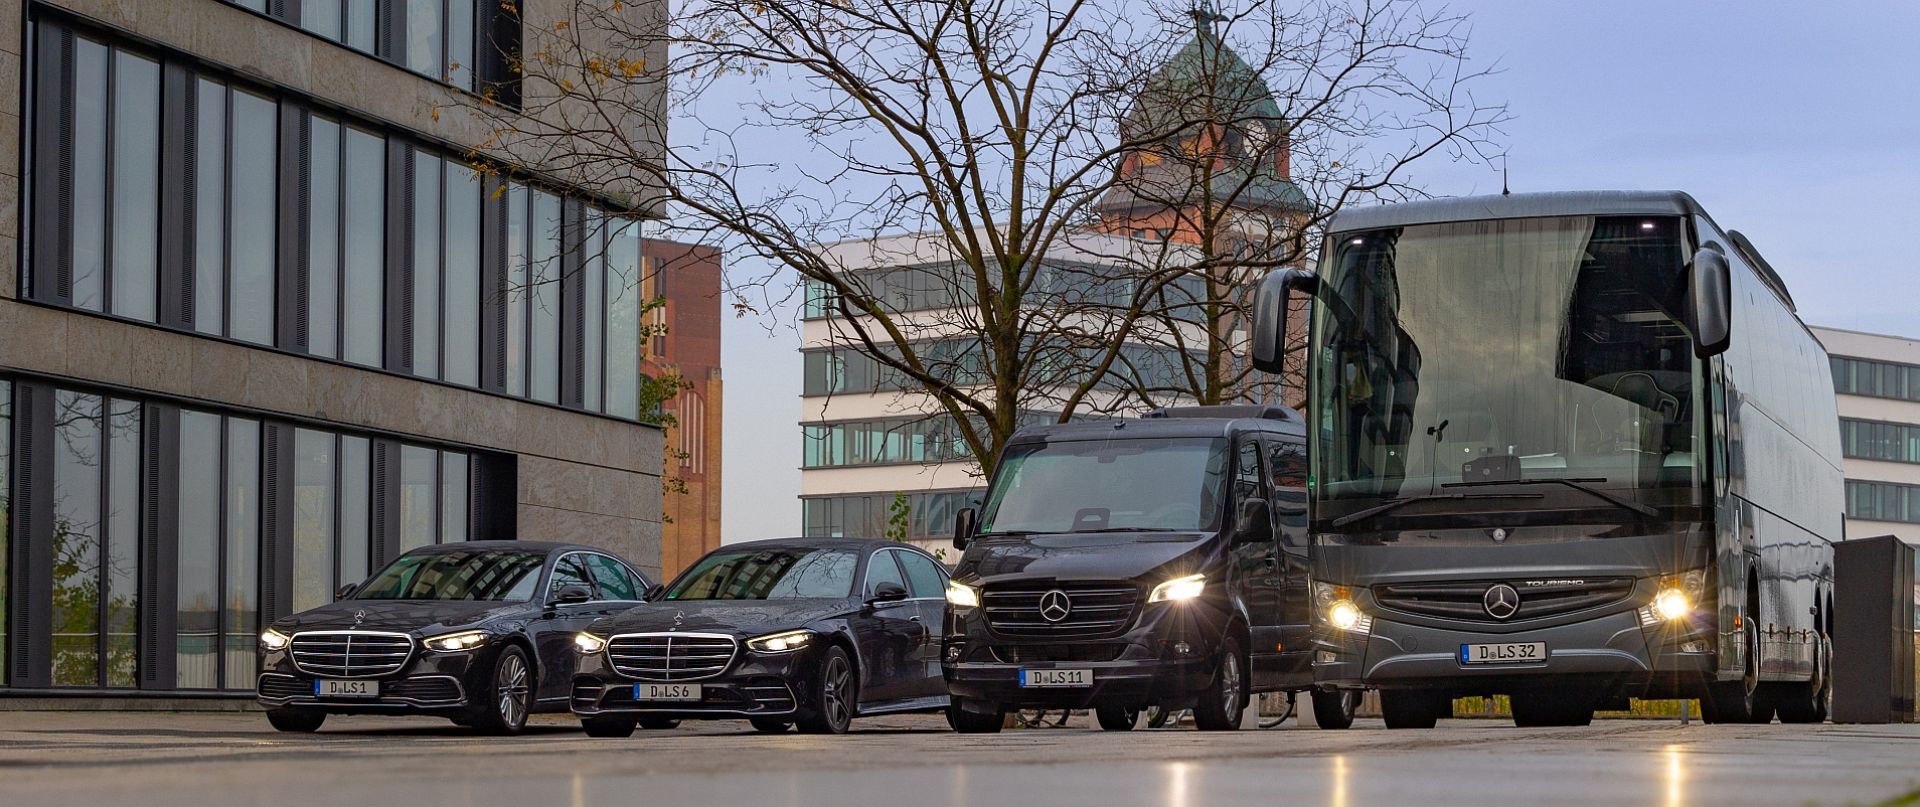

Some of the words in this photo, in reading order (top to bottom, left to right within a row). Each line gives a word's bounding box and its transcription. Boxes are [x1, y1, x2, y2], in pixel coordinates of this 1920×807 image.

[1479, 645, 1488, 659] D
[1034, 672, 1042, 683] D
[330, 682, 337, 693] D
[650, 686, 658, 697] D
